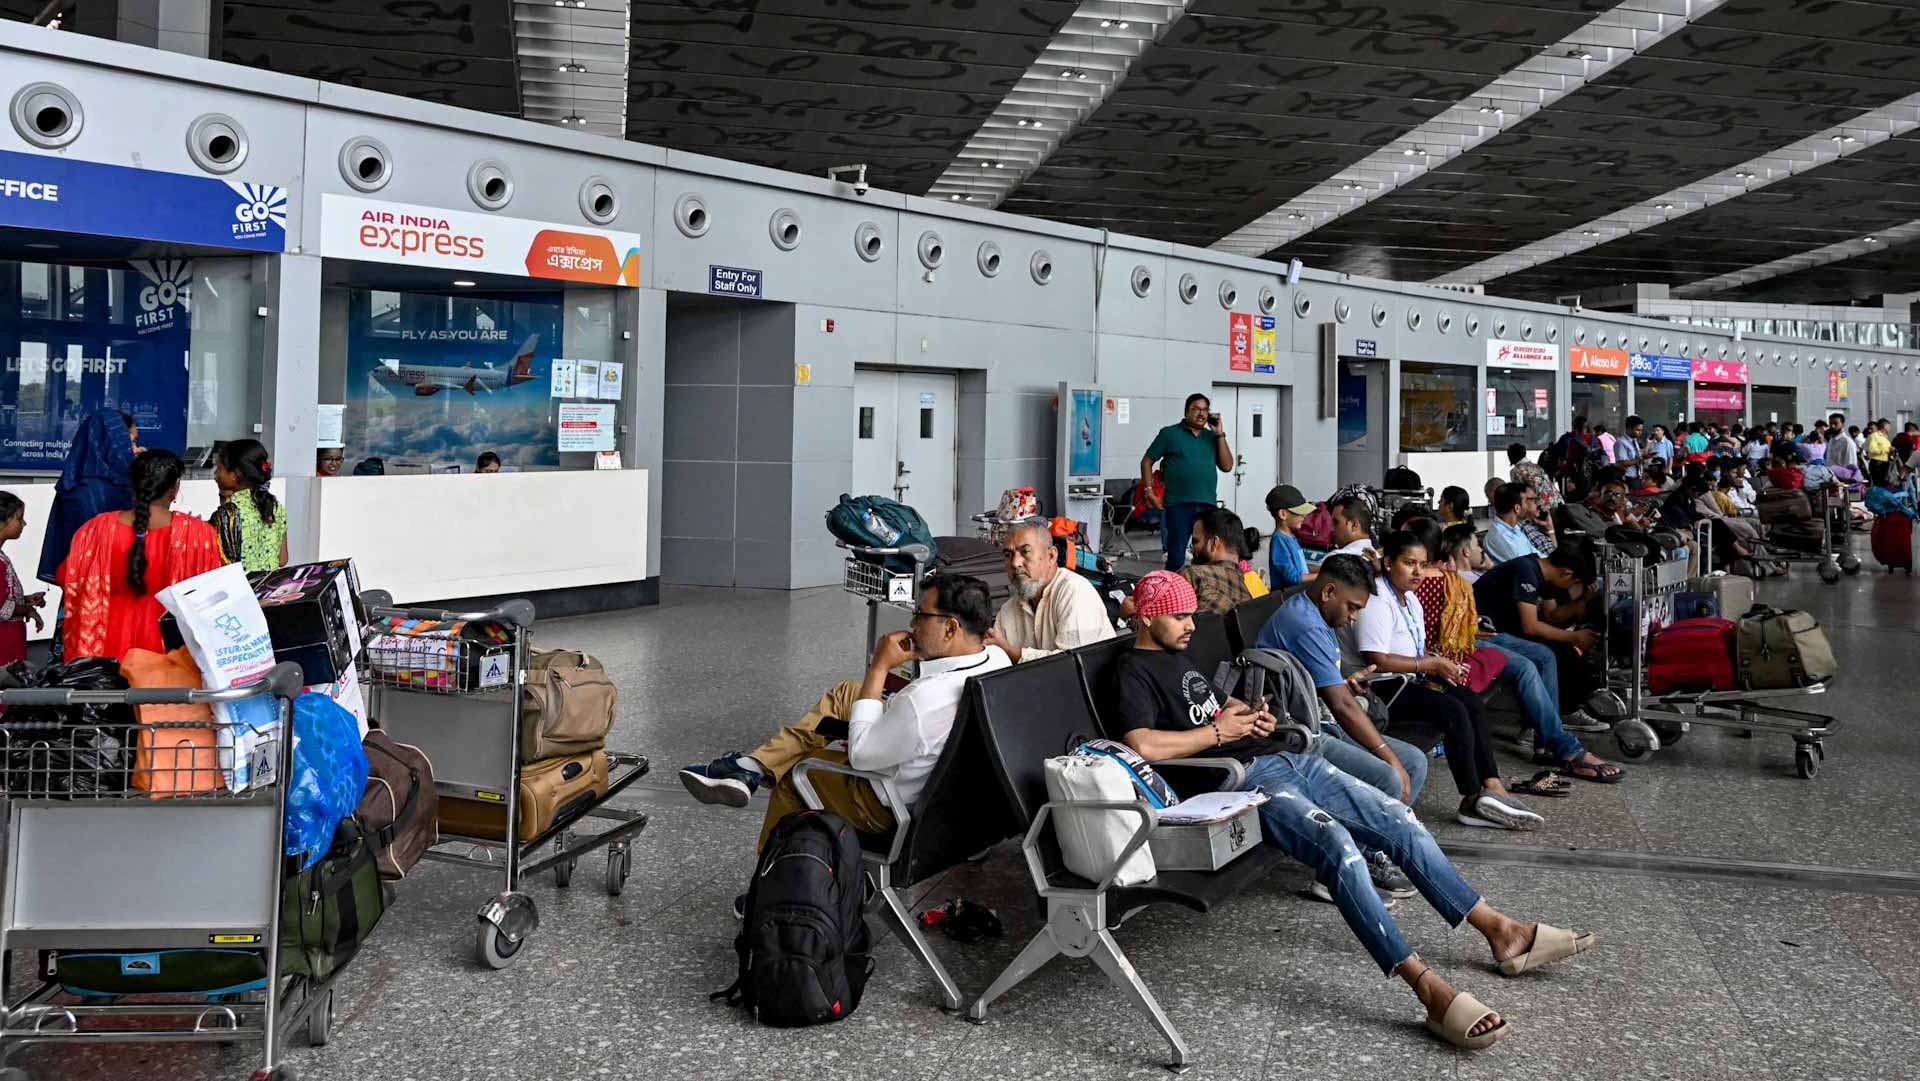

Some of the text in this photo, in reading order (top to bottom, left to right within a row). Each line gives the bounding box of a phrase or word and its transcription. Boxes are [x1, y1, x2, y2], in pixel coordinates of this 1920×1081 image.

[236, 202, 269, 222] GO
[361, 210, 450, 230] AIR INDIA
[232, 221, 267, 233] FIRST
[360, 225, 484, 258] express
[547, 255, 603, 271] এক্সপ্রেস
[716, 269, 756, 282] Entry For
[139, 280, 177, 311] GO
[715, 280, 757, 295] Staff Only
[136, 307, 174, 327] FIRST
[402, 330, 508, 340] FLY AS YOU ARE
[52, 357, 78, 373] GO
[81, 358, 127, 374] FIRST
[3, 438, 44, 449] Connecting
[45, 450, 64, 458] India
